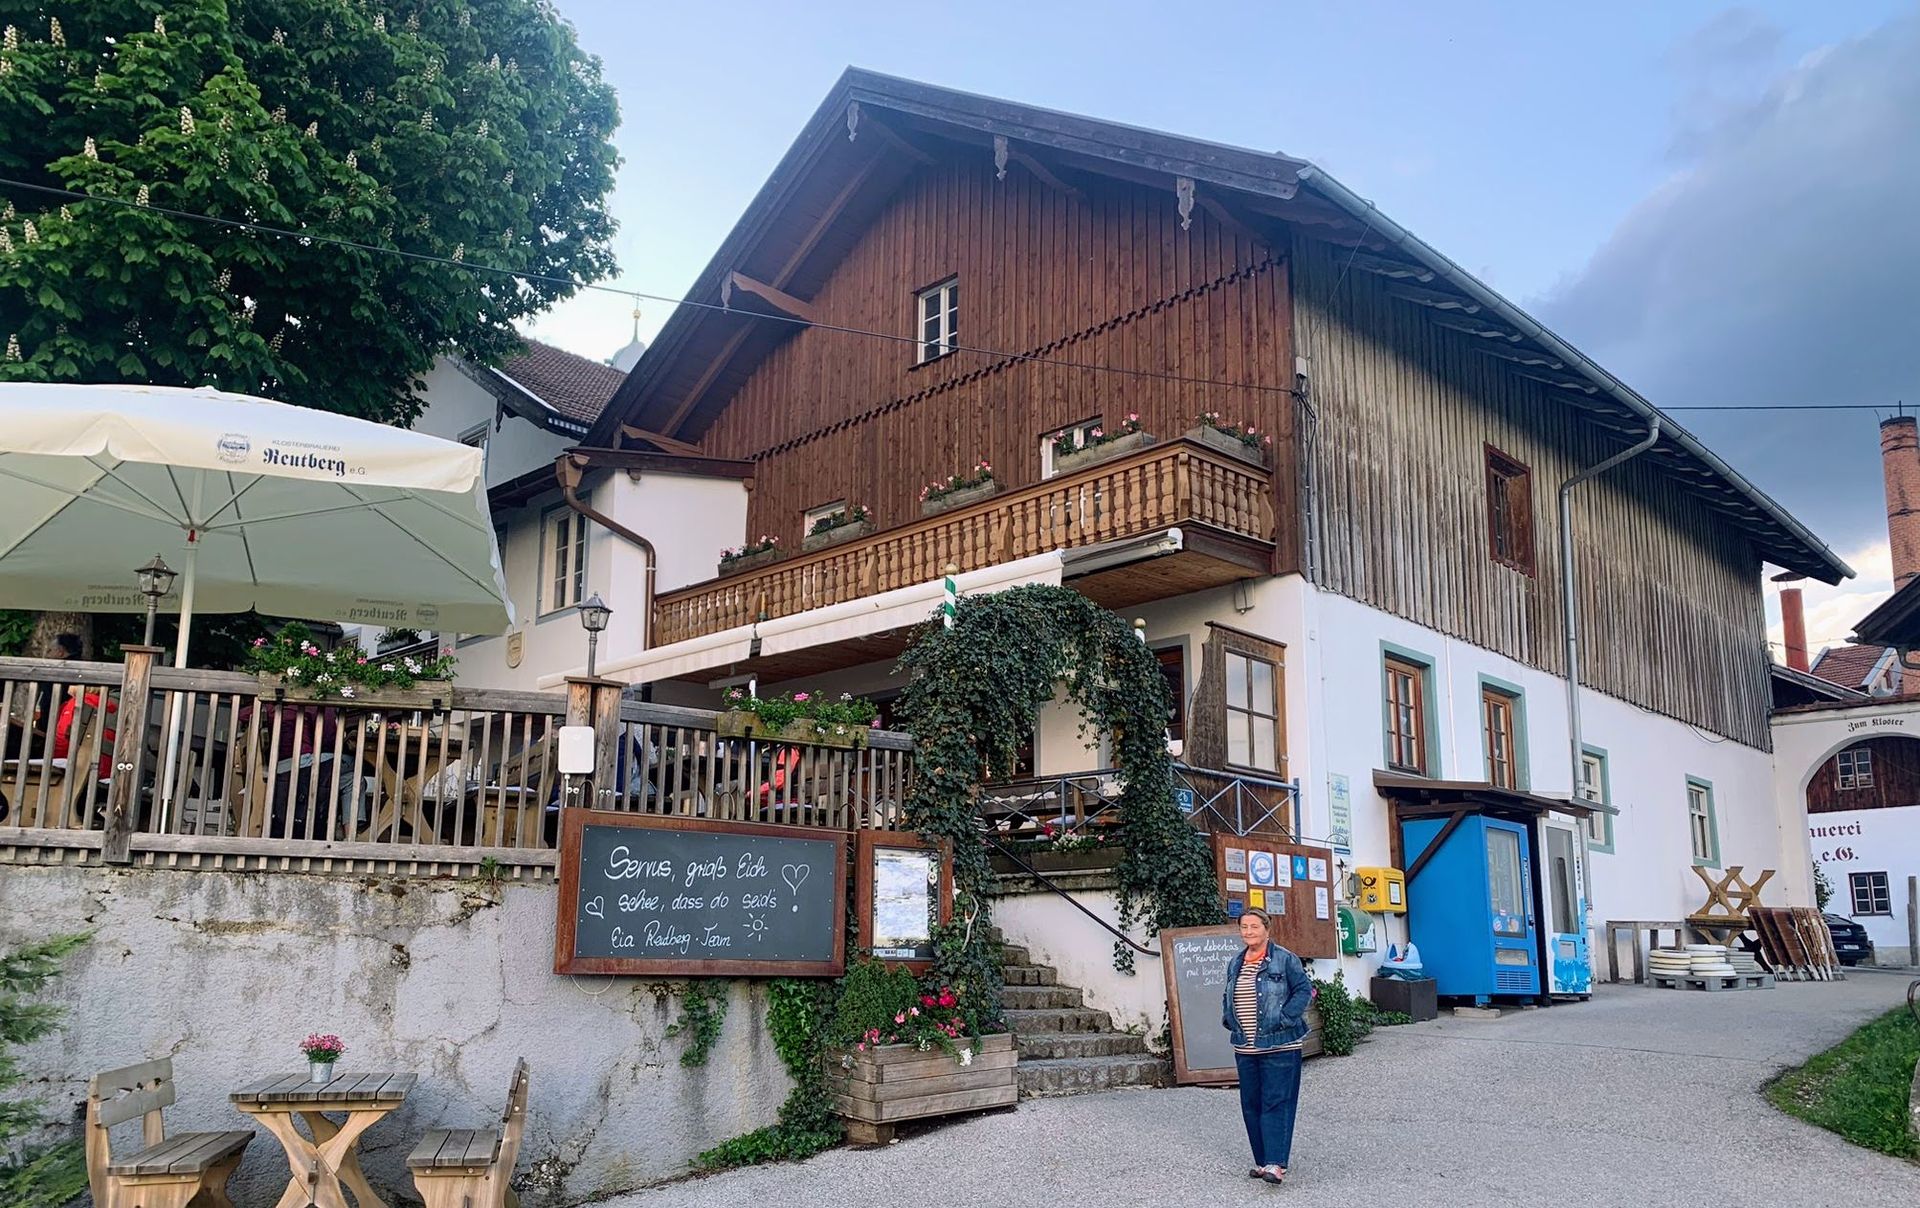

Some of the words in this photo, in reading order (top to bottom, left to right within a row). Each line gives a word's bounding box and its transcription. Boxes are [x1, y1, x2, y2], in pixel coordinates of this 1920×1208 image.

[272, 440, 341, 451] KLOSTERBRAUEREI
[263, 448, 345, 477] Reutberg
[1848, 720, 1867, 733] Zum
[1872, 718, 1904, 727] Kloster
[604, 845, 677, 883] Servus,
[736, 852, 769, 880] Eich
[672, 893, 704, 910] dass
[710, 891, 729, 910] do
